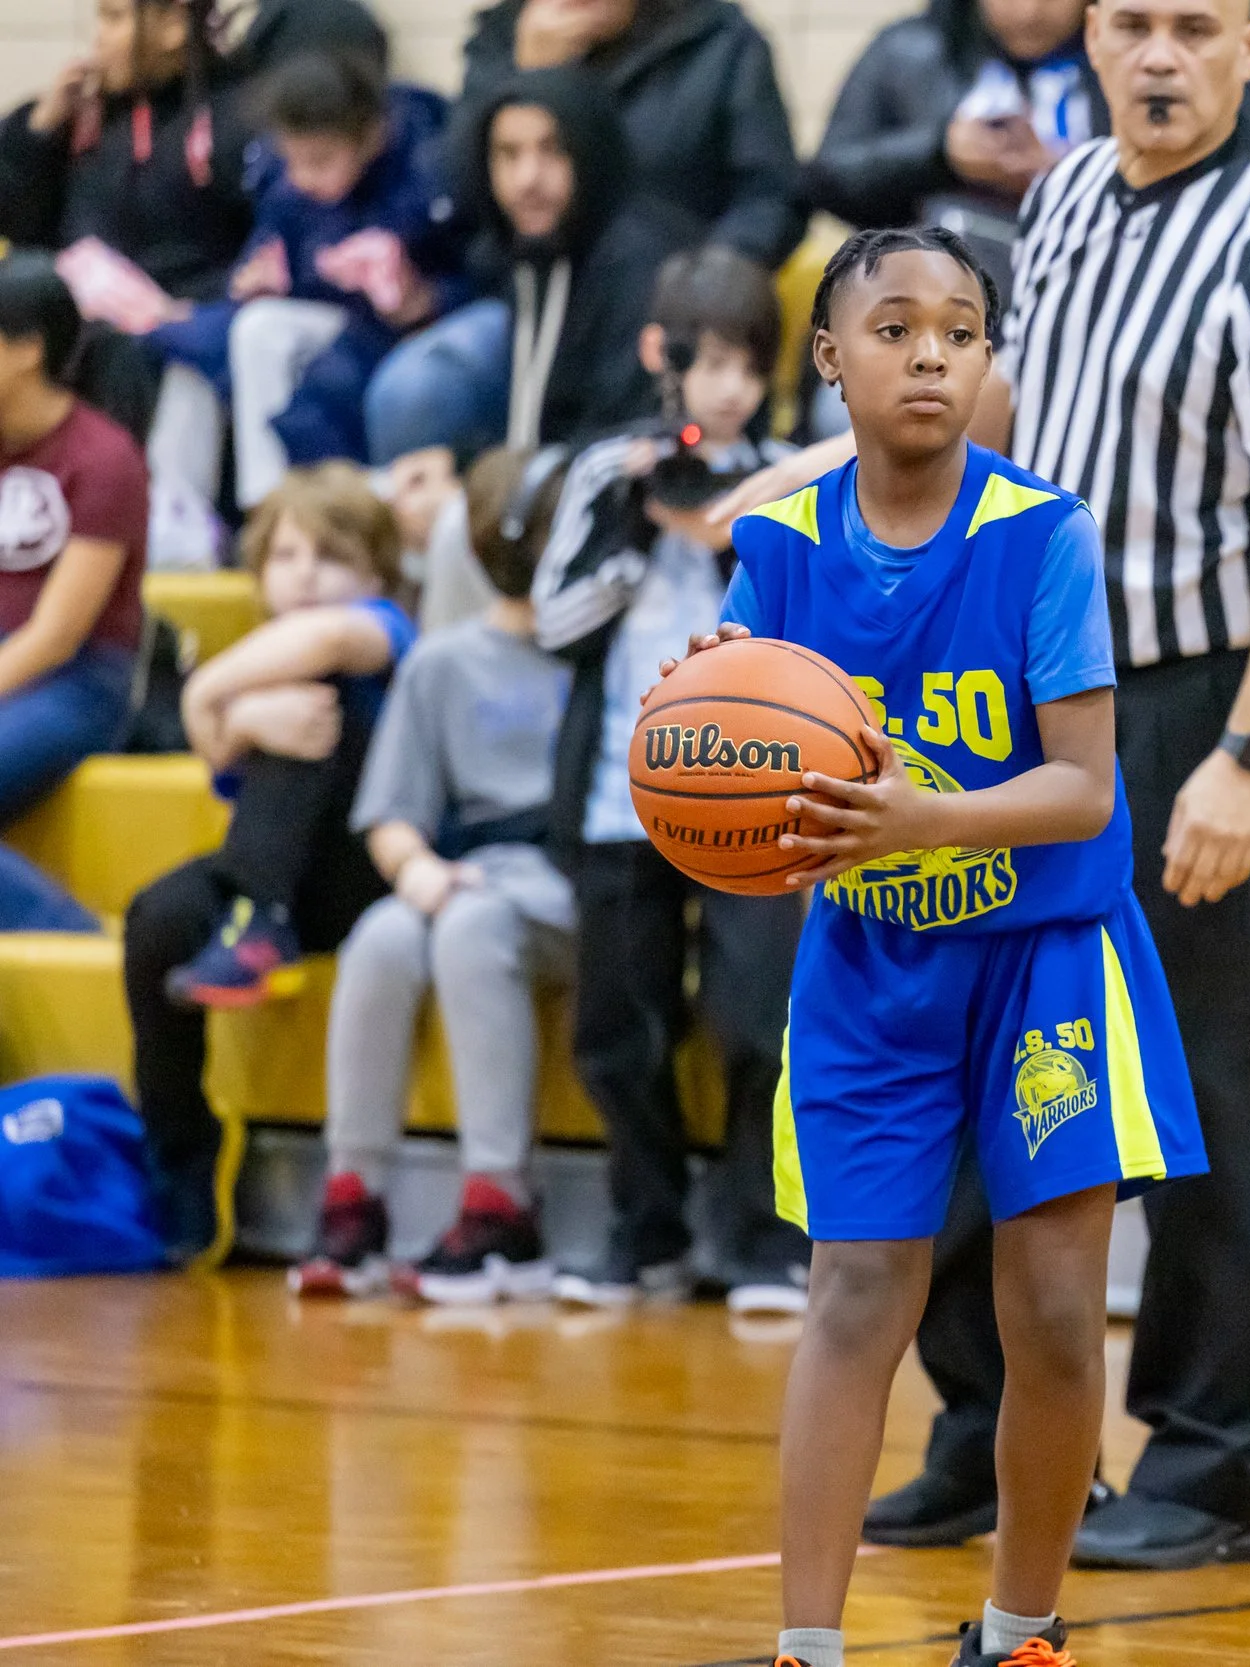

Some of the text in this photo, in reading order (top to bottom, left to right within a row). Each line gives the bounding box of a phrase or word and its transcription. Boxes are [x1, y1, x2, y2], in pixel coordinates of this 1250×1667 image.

[917, 669, 1012, 762] 50
[645, 722, 802, 773] Wilson
[653, 816, 802, 848] EVOLUTION
[1056, 1018, 1094, 1051] 50
[1017, 1085, 1096, 1151] WARRIORS
